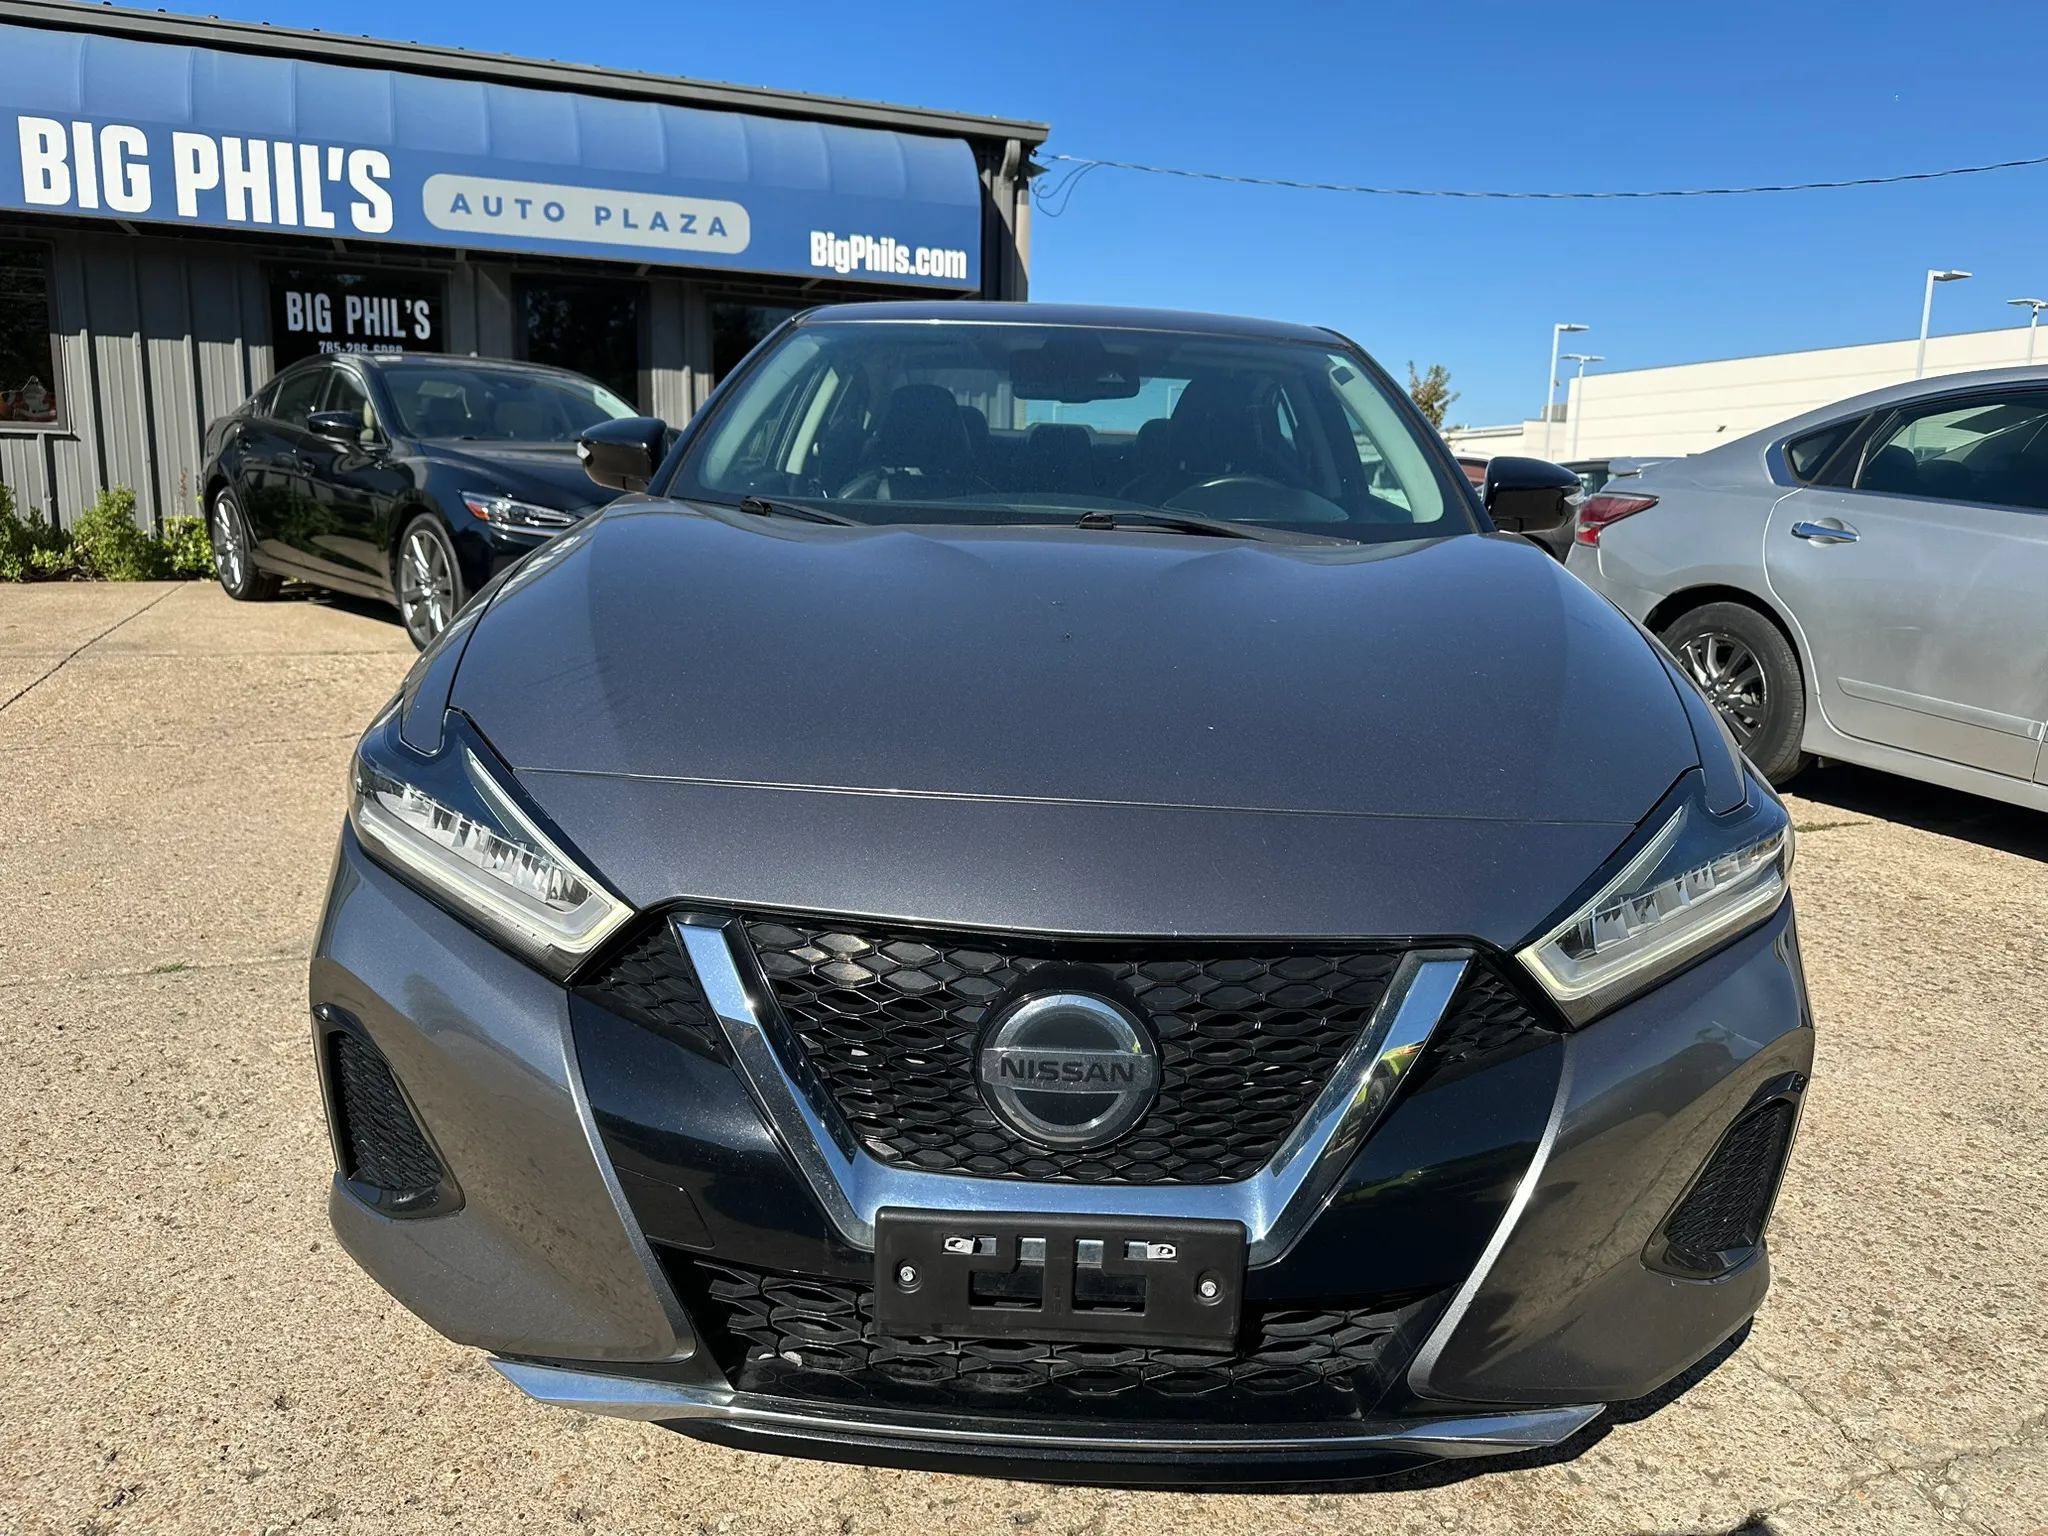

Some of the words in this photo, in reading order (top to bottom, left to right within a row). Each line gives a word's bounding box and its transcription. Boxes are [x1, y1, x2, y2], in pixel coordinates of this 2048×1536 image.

[17, 115, 152, 213] BIG
[172, 131, 394, 233] PHIL'S
[450, 193, 565, 222] AUTO
[594, 206, 728, 237] PLAZA
[810, 230, 967, 279] BigPhils.com
[286, 291, 333, 334] BIG
[345, 295, 431, 340] PHIL'S
[1000, 1057, 1135, 1083] NISSAN
